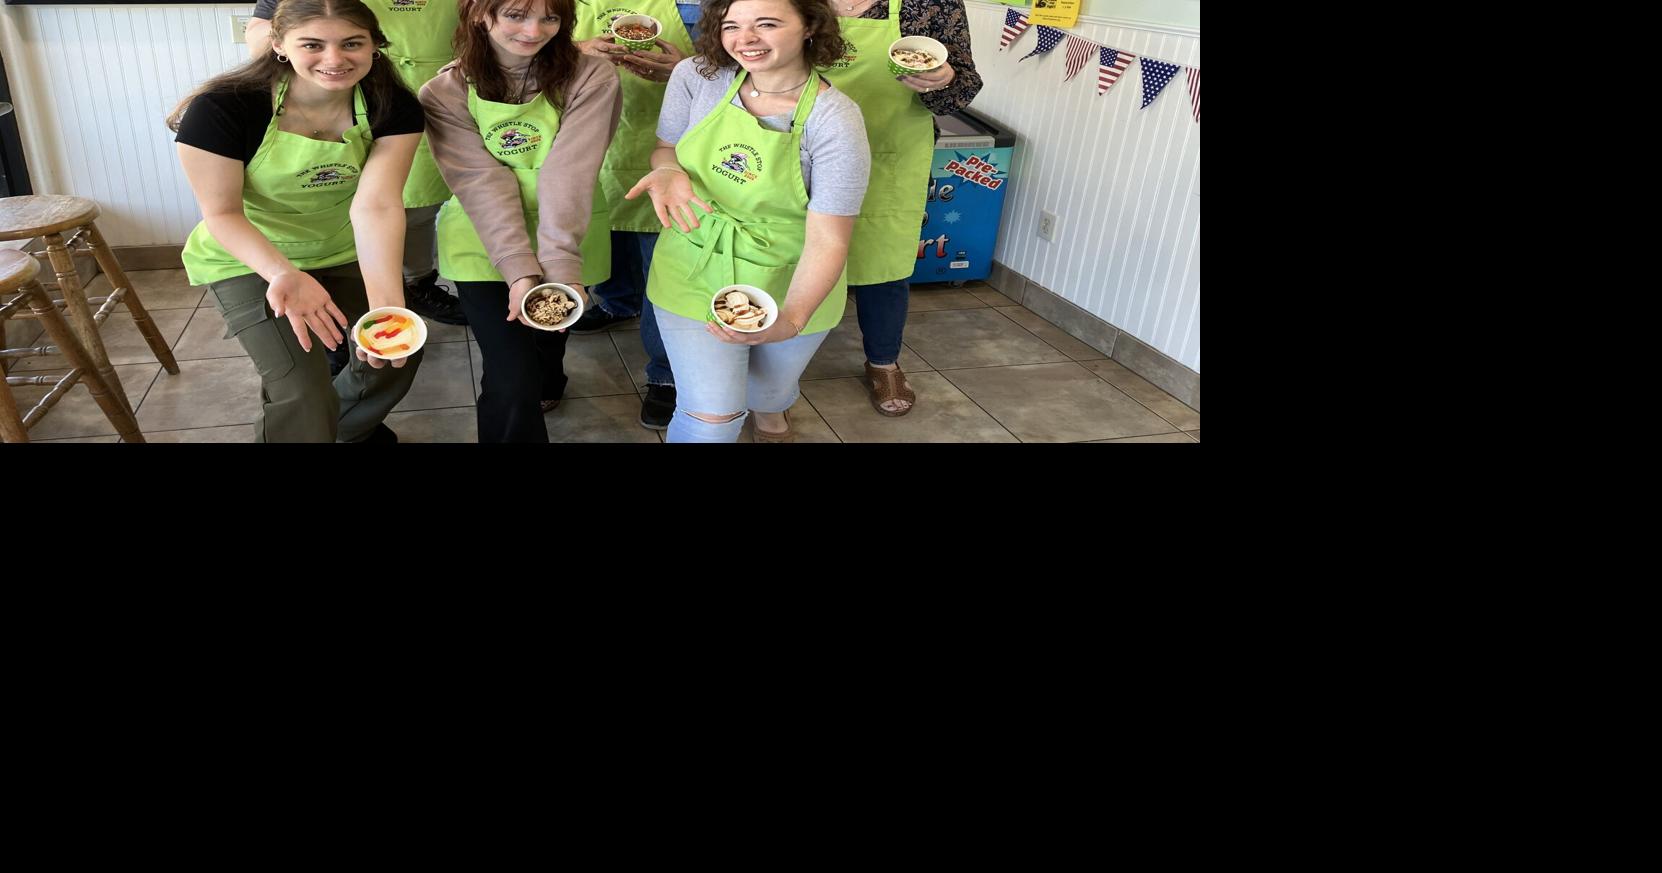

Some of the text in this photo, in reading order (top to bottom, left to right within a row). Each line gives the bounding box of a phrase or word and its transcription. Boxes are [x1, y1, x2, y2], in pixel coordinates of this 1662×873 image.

[491, 121, 522, 132] WHISTLE
[523, 122, 540, 133] STOP
[497, 144, 538, 156] YOGURT
[718, 143, 763, 172] THE WHISTLE STOP
[311, 162, 347, 171] WHISTLE
[966, 156, 997, 174] Pre-
[711, 164, 747, 185] YOGURT
[945, 160, 1002, 190] Packed
[301, 180, 346, 189] YOGURT
